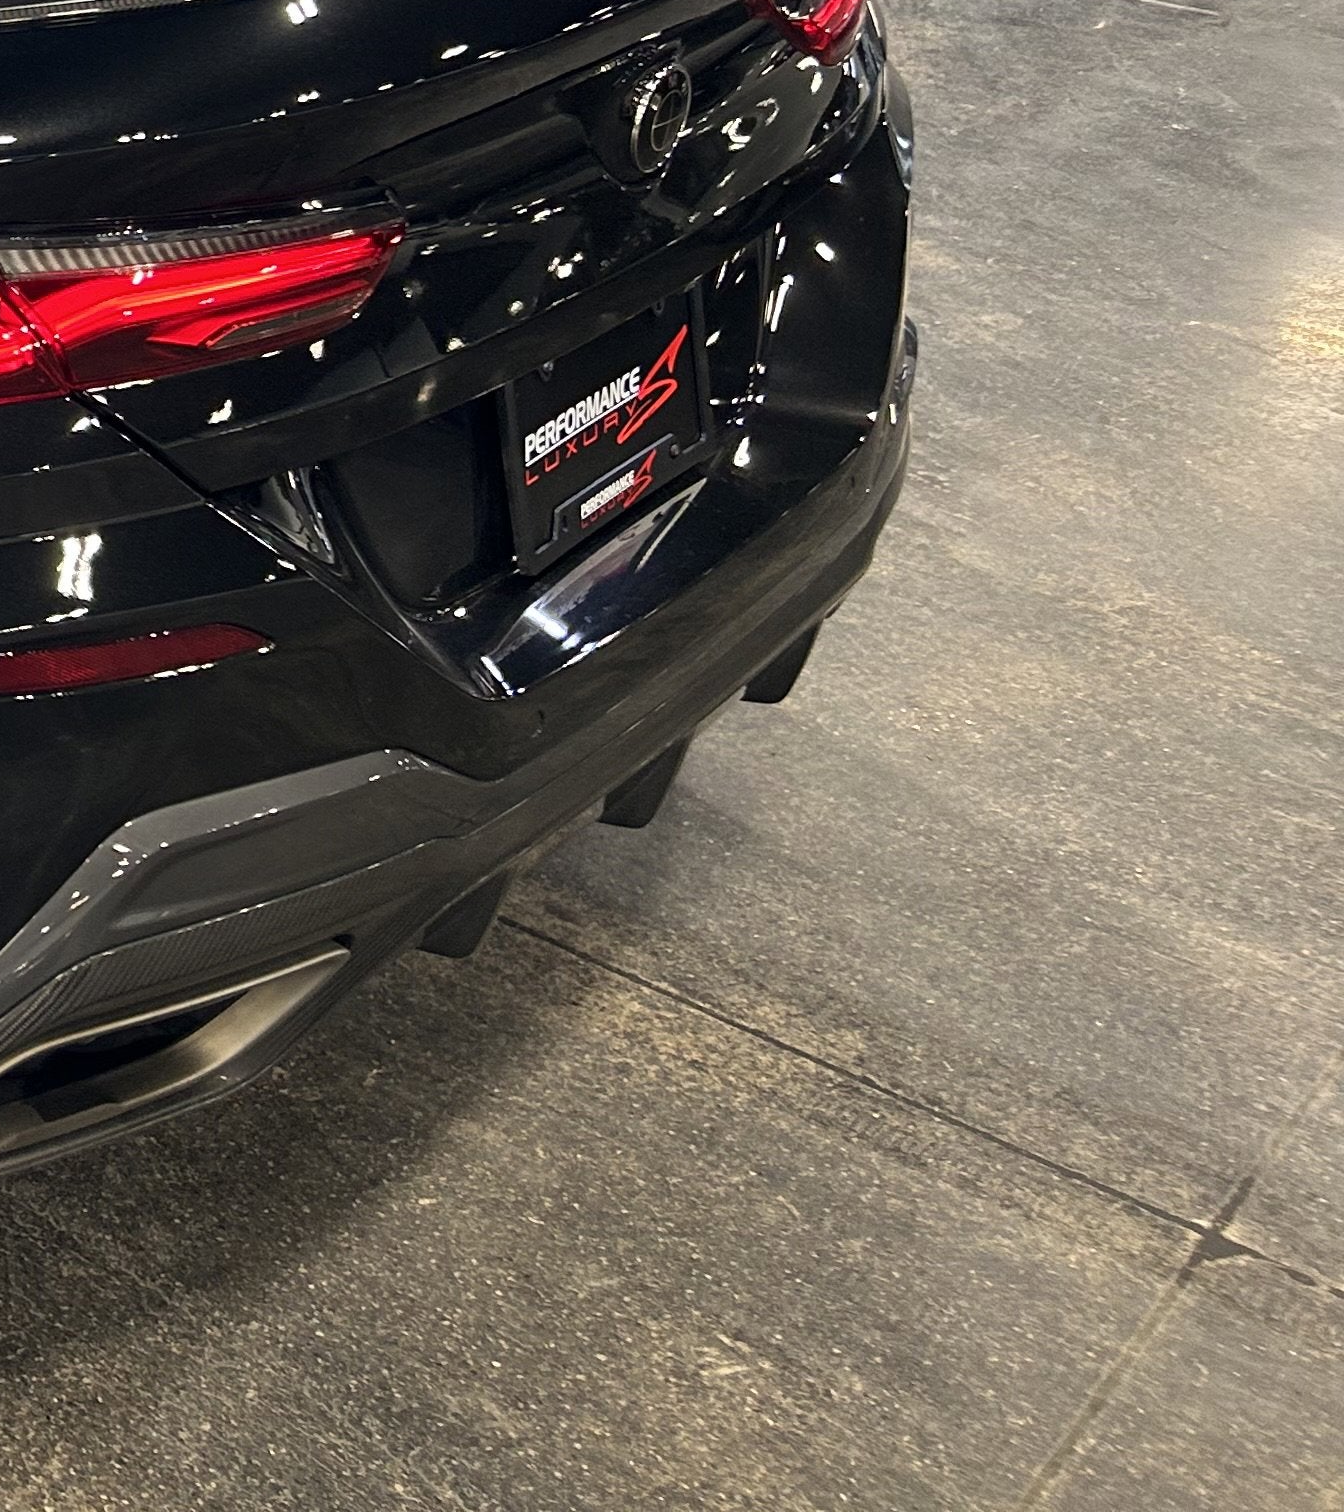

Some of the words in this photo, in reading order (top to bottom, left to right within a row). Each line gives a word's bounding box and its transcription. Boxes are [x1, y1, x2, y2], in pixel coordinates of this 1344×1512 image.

[524, 366, 641, 463] PERFORMANCE
[525, 399, 652, 486] LUXURY
[580, 470, 635, 519] PERFORMANCE
